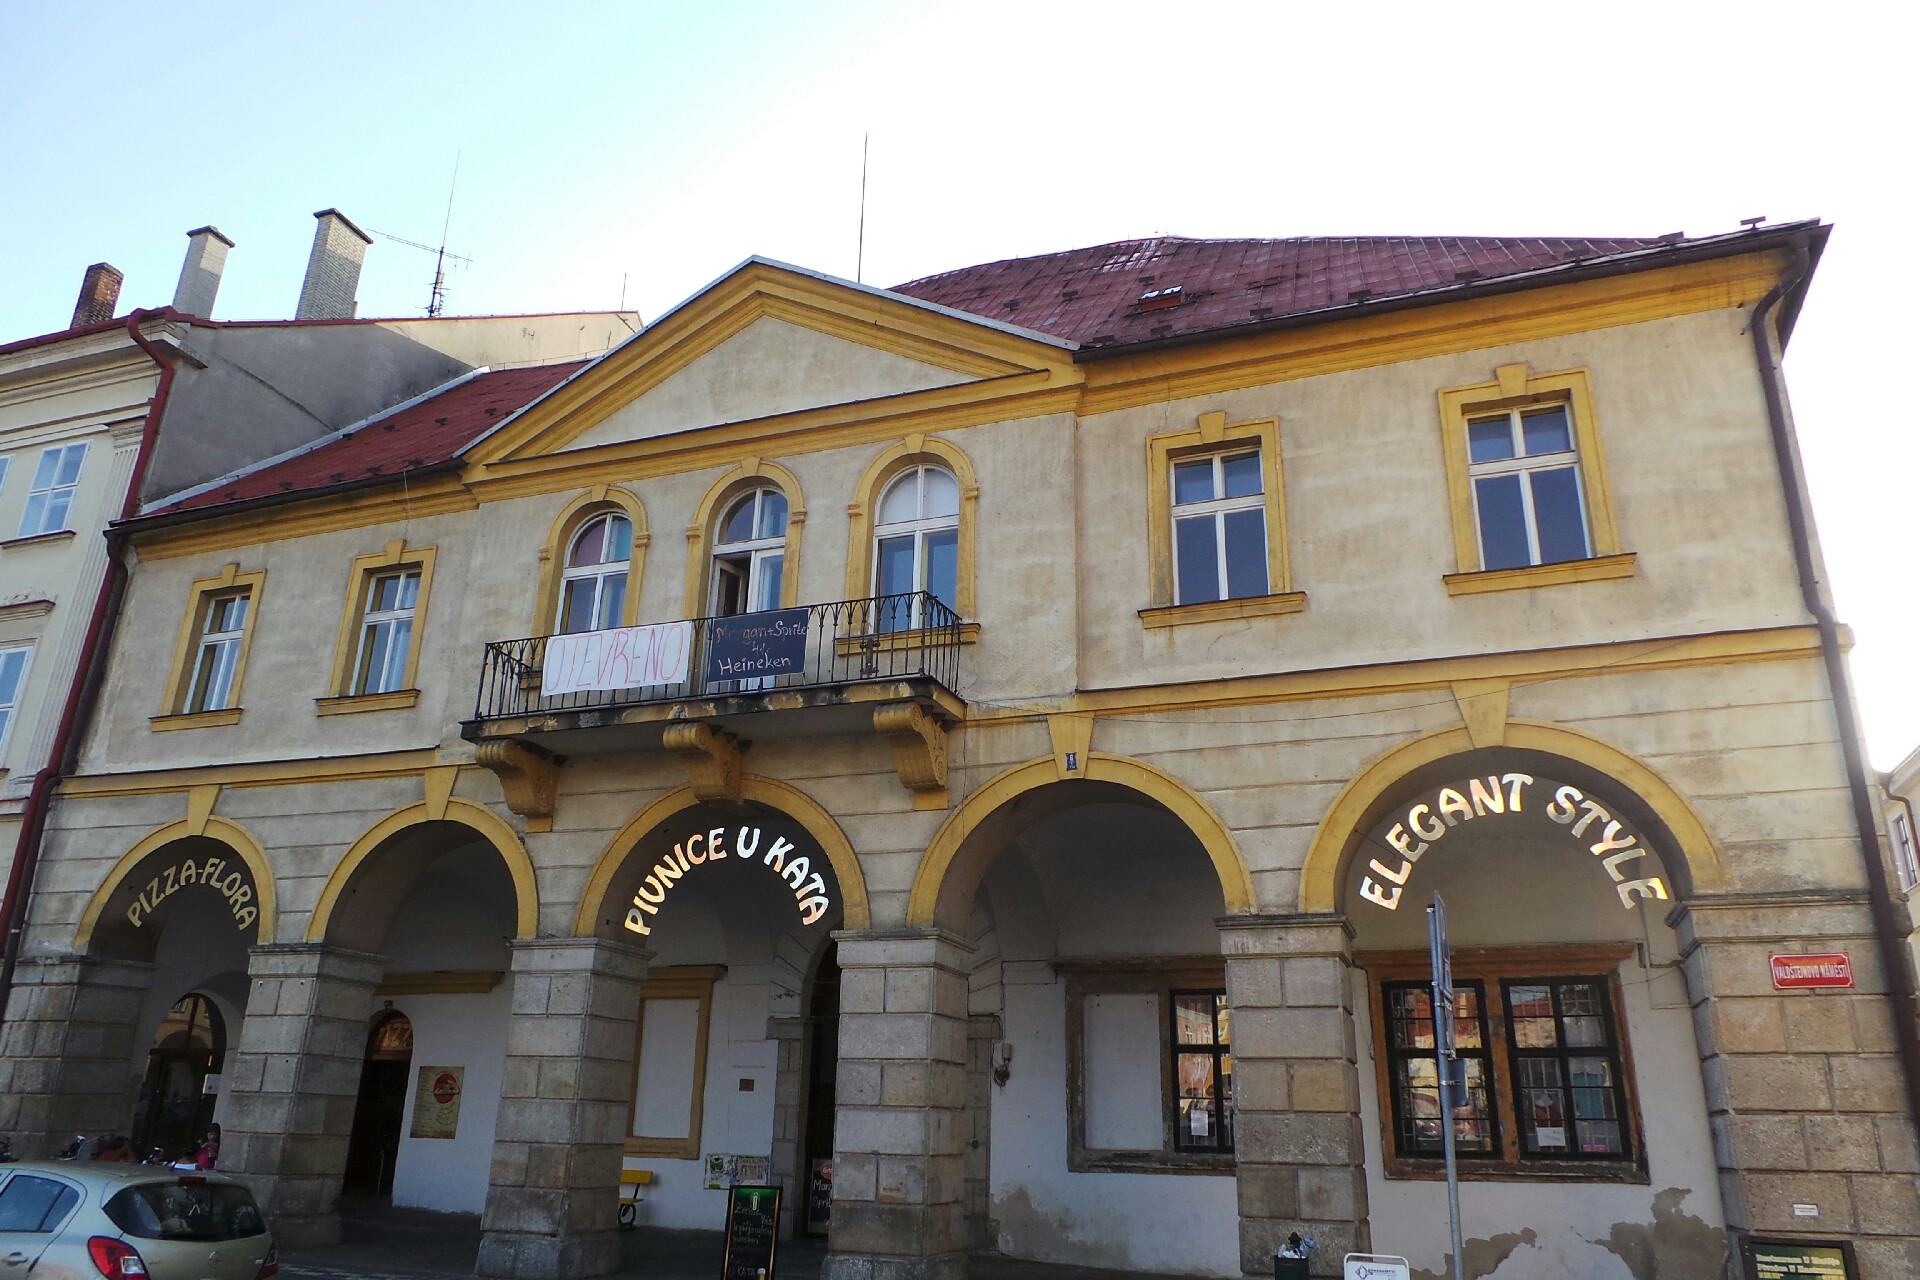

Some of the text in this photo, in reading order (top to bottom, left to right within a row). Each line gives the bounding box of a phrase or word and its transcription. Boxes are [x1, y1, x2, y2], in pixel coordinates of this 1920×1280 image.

[545, 624, 684, 692] OTEVŘENO
[718, 652, 791, 676] Heineken
[736, 826, 761, 859] U
[763, 836, 830, 926] KATA
[1359, 773, 1668, 910] ELEGANT STYLE
[127, 857, 257, 931] PIZZA-FLORA
